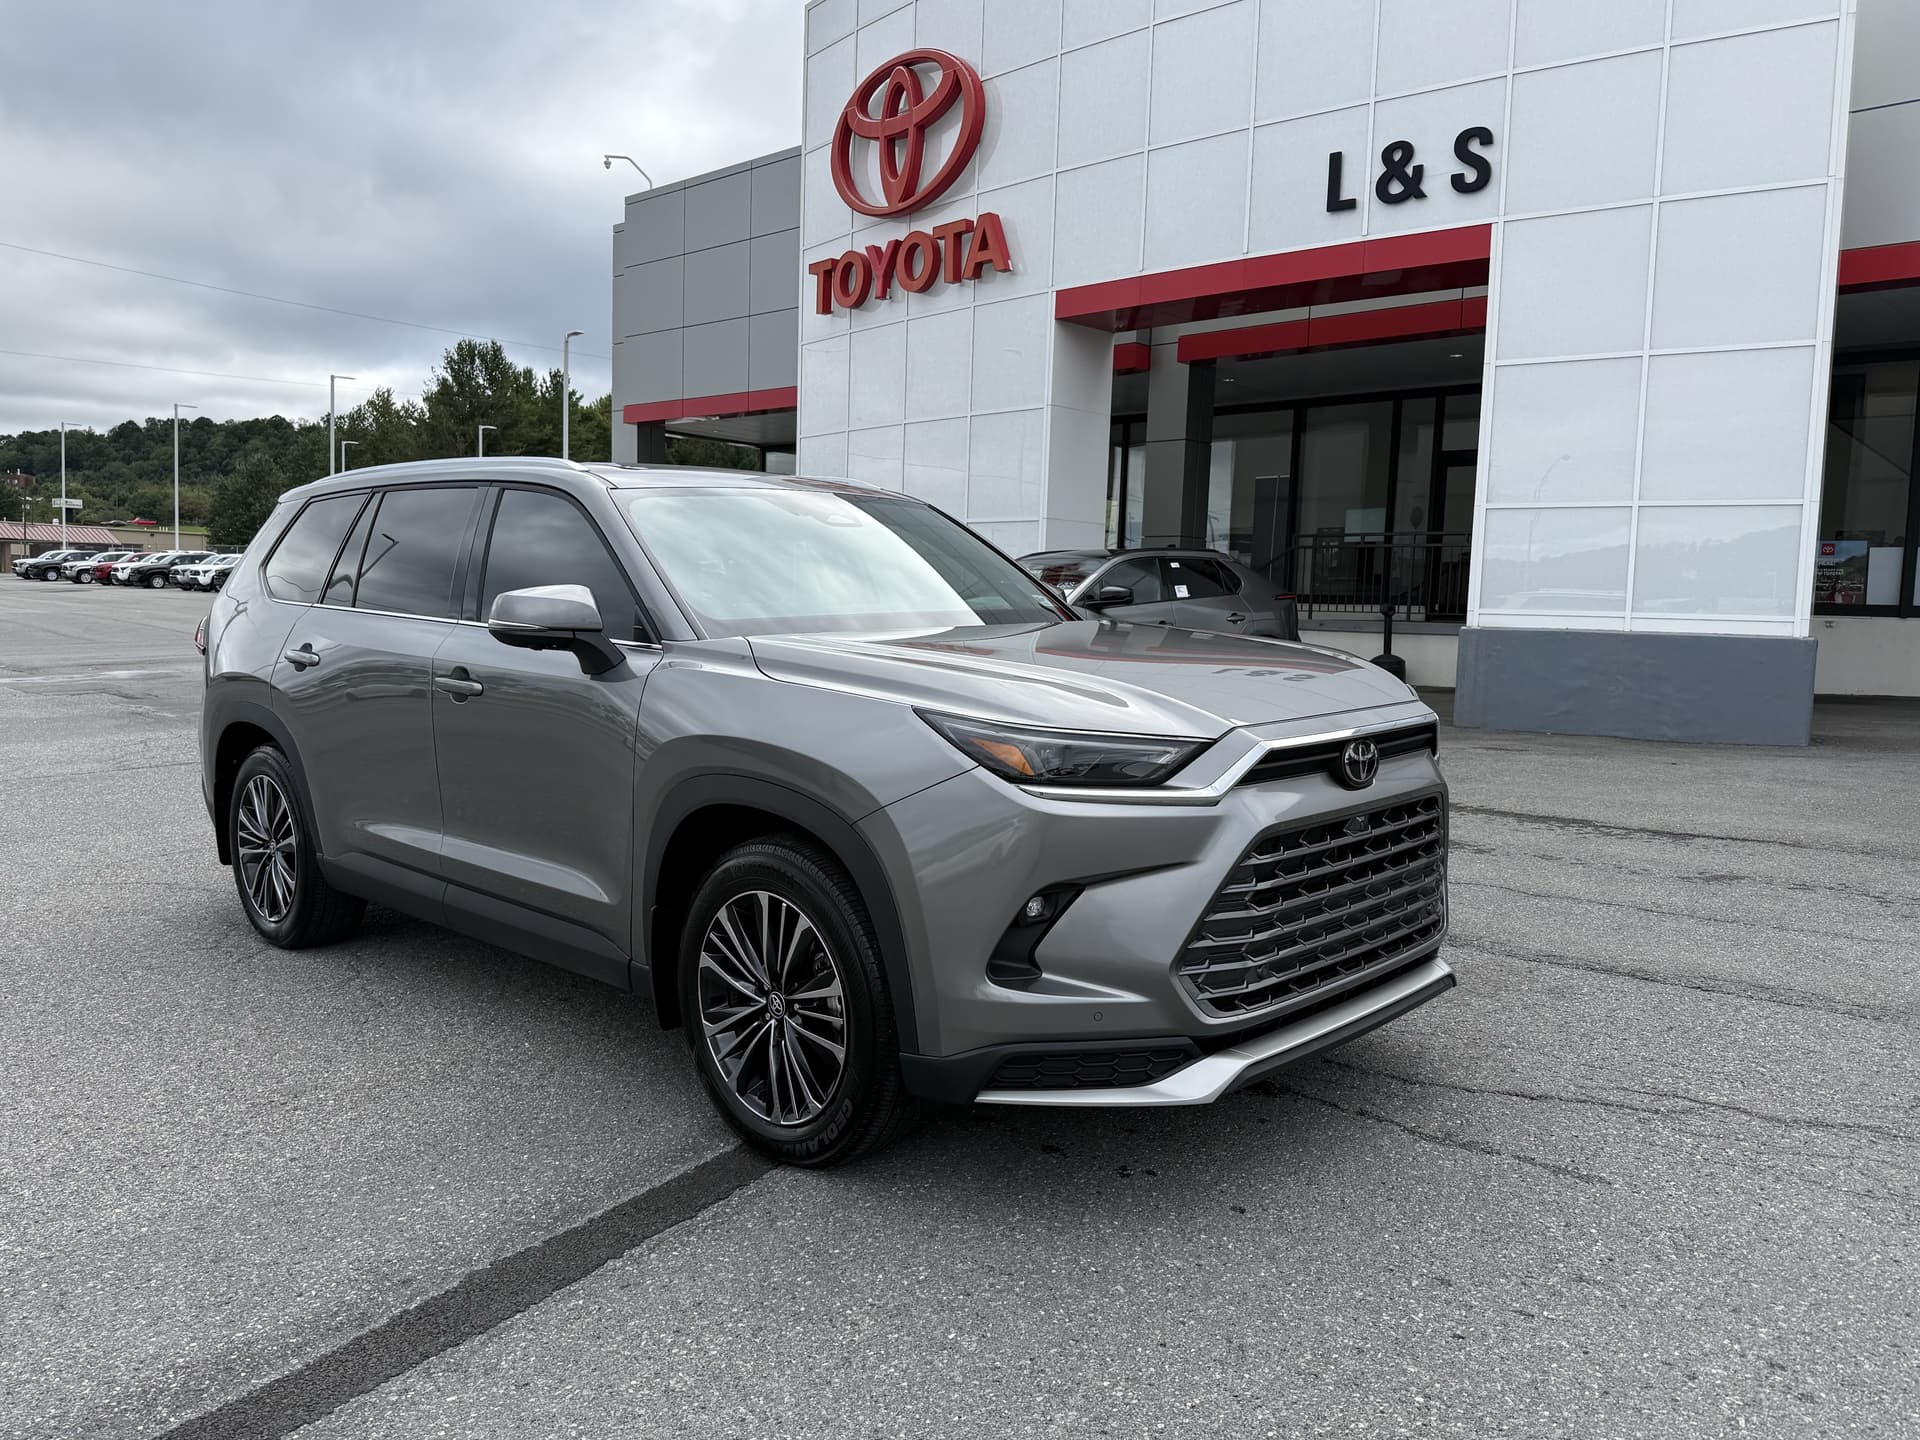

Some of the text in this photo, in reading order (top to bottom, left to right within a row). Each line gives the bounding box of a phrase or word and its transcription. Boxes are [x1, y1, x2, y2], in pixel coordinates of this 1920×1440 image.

[1327, 126, 1494, 212] L & S
[809, 212, 1013, 314] TOYOTA
